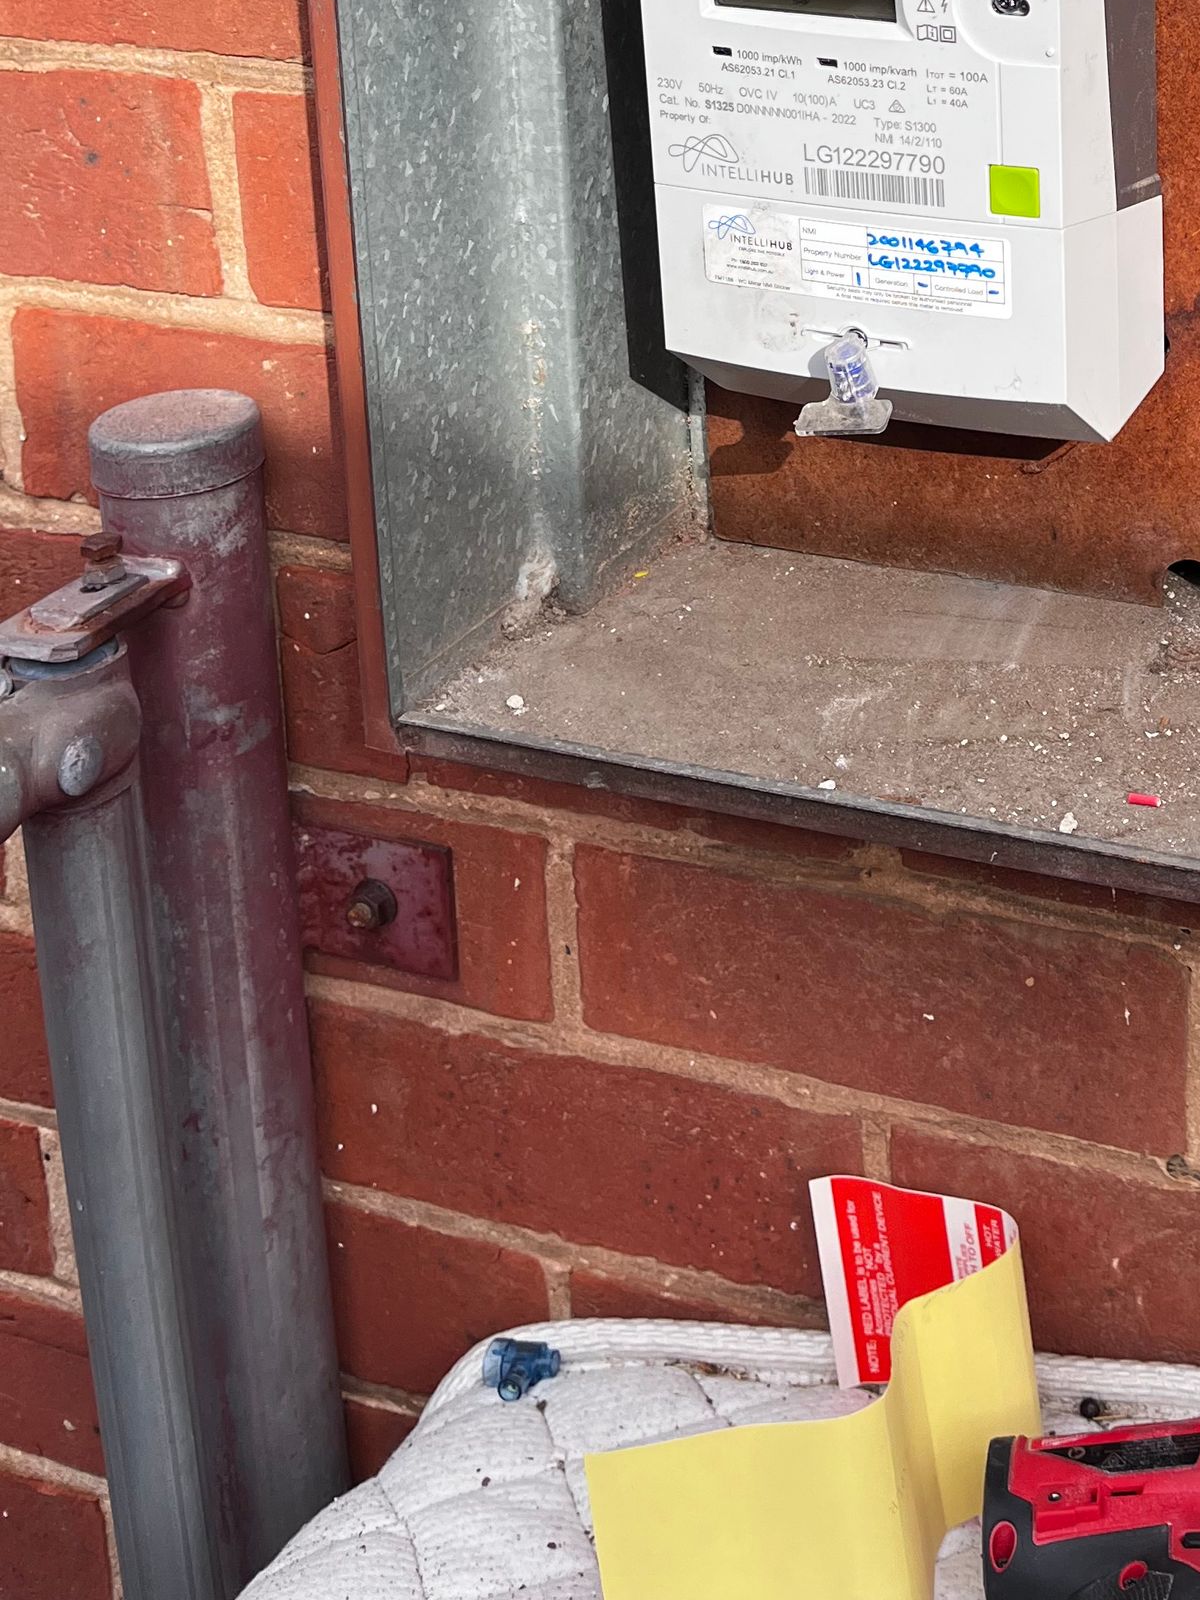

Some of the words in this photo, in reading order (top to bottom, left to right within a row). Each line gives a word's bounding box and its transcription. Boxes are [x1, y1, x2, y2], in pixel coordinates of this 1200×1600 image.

[737, 49, 759, 61] 1000
[762, 52, 803, 66] imp/kWh
[721, 62, 776, 78] AS62053.21
[843, 61, 867, 73] 1000
[869, 63, 918, 78] imp/kvarh
[960, 71, 989, 84] 100A
[828, 74, 885, 90] AS62053.23
[657, 77, 683, 90] 230V
[698, 82, 724, 95] 50Hz
[739, 87, 762, 100] OVC
[766, 89, 778, 101] IV
[793, 92, 838, 108] 10(100)A
[853, 99, 876, 111] UC3
[949, 85, 969, 97] 60A
[684, 97, 701, 109] No.
[704, 99, 735, 113] S1325
[832, 113, 857, 126] 2022
[949, 97, 969, 109] 40A
[659, 109, 696, 124] Property
[873, 117, 902, 132] Type:
[904, 120, 937, 134] S1300
[874, 133, 894, 145] NMI
[803, 143, 946, 175] LG122297790
[701, 163, 794, 186] INTELLIHUB
[802, 226, 817, 236] NMI
[730, 234, 793, 251] INTELLIHUB
[803, 246, 833, 259] Property
[834, 250, 862, 261] Number
[826, 270, 845, 279] Power
[867, 253, 996, 280] LG122297790
[875, 276, 909, 288] Generation
[934, 284, 967, 295] Controlled
[968, 287, 984, 297] Load
[846, 1200, 856, 1214] for
[872, 1191, 888, 1232] DEVICE
[847, 1215, 860, 1239] used
[963, 1221, 975, 1245] OFF
[982, 1223, 993, 1248] HOT
[880, 1232, 895, 1285] CURRENT
[968, 1247, 977, 1262] TO
[857, 1277, 871, 1311] LABEL
[861, 1311, 875, 1336] RED
[866, 1340, 881, 1374] NOTE:
